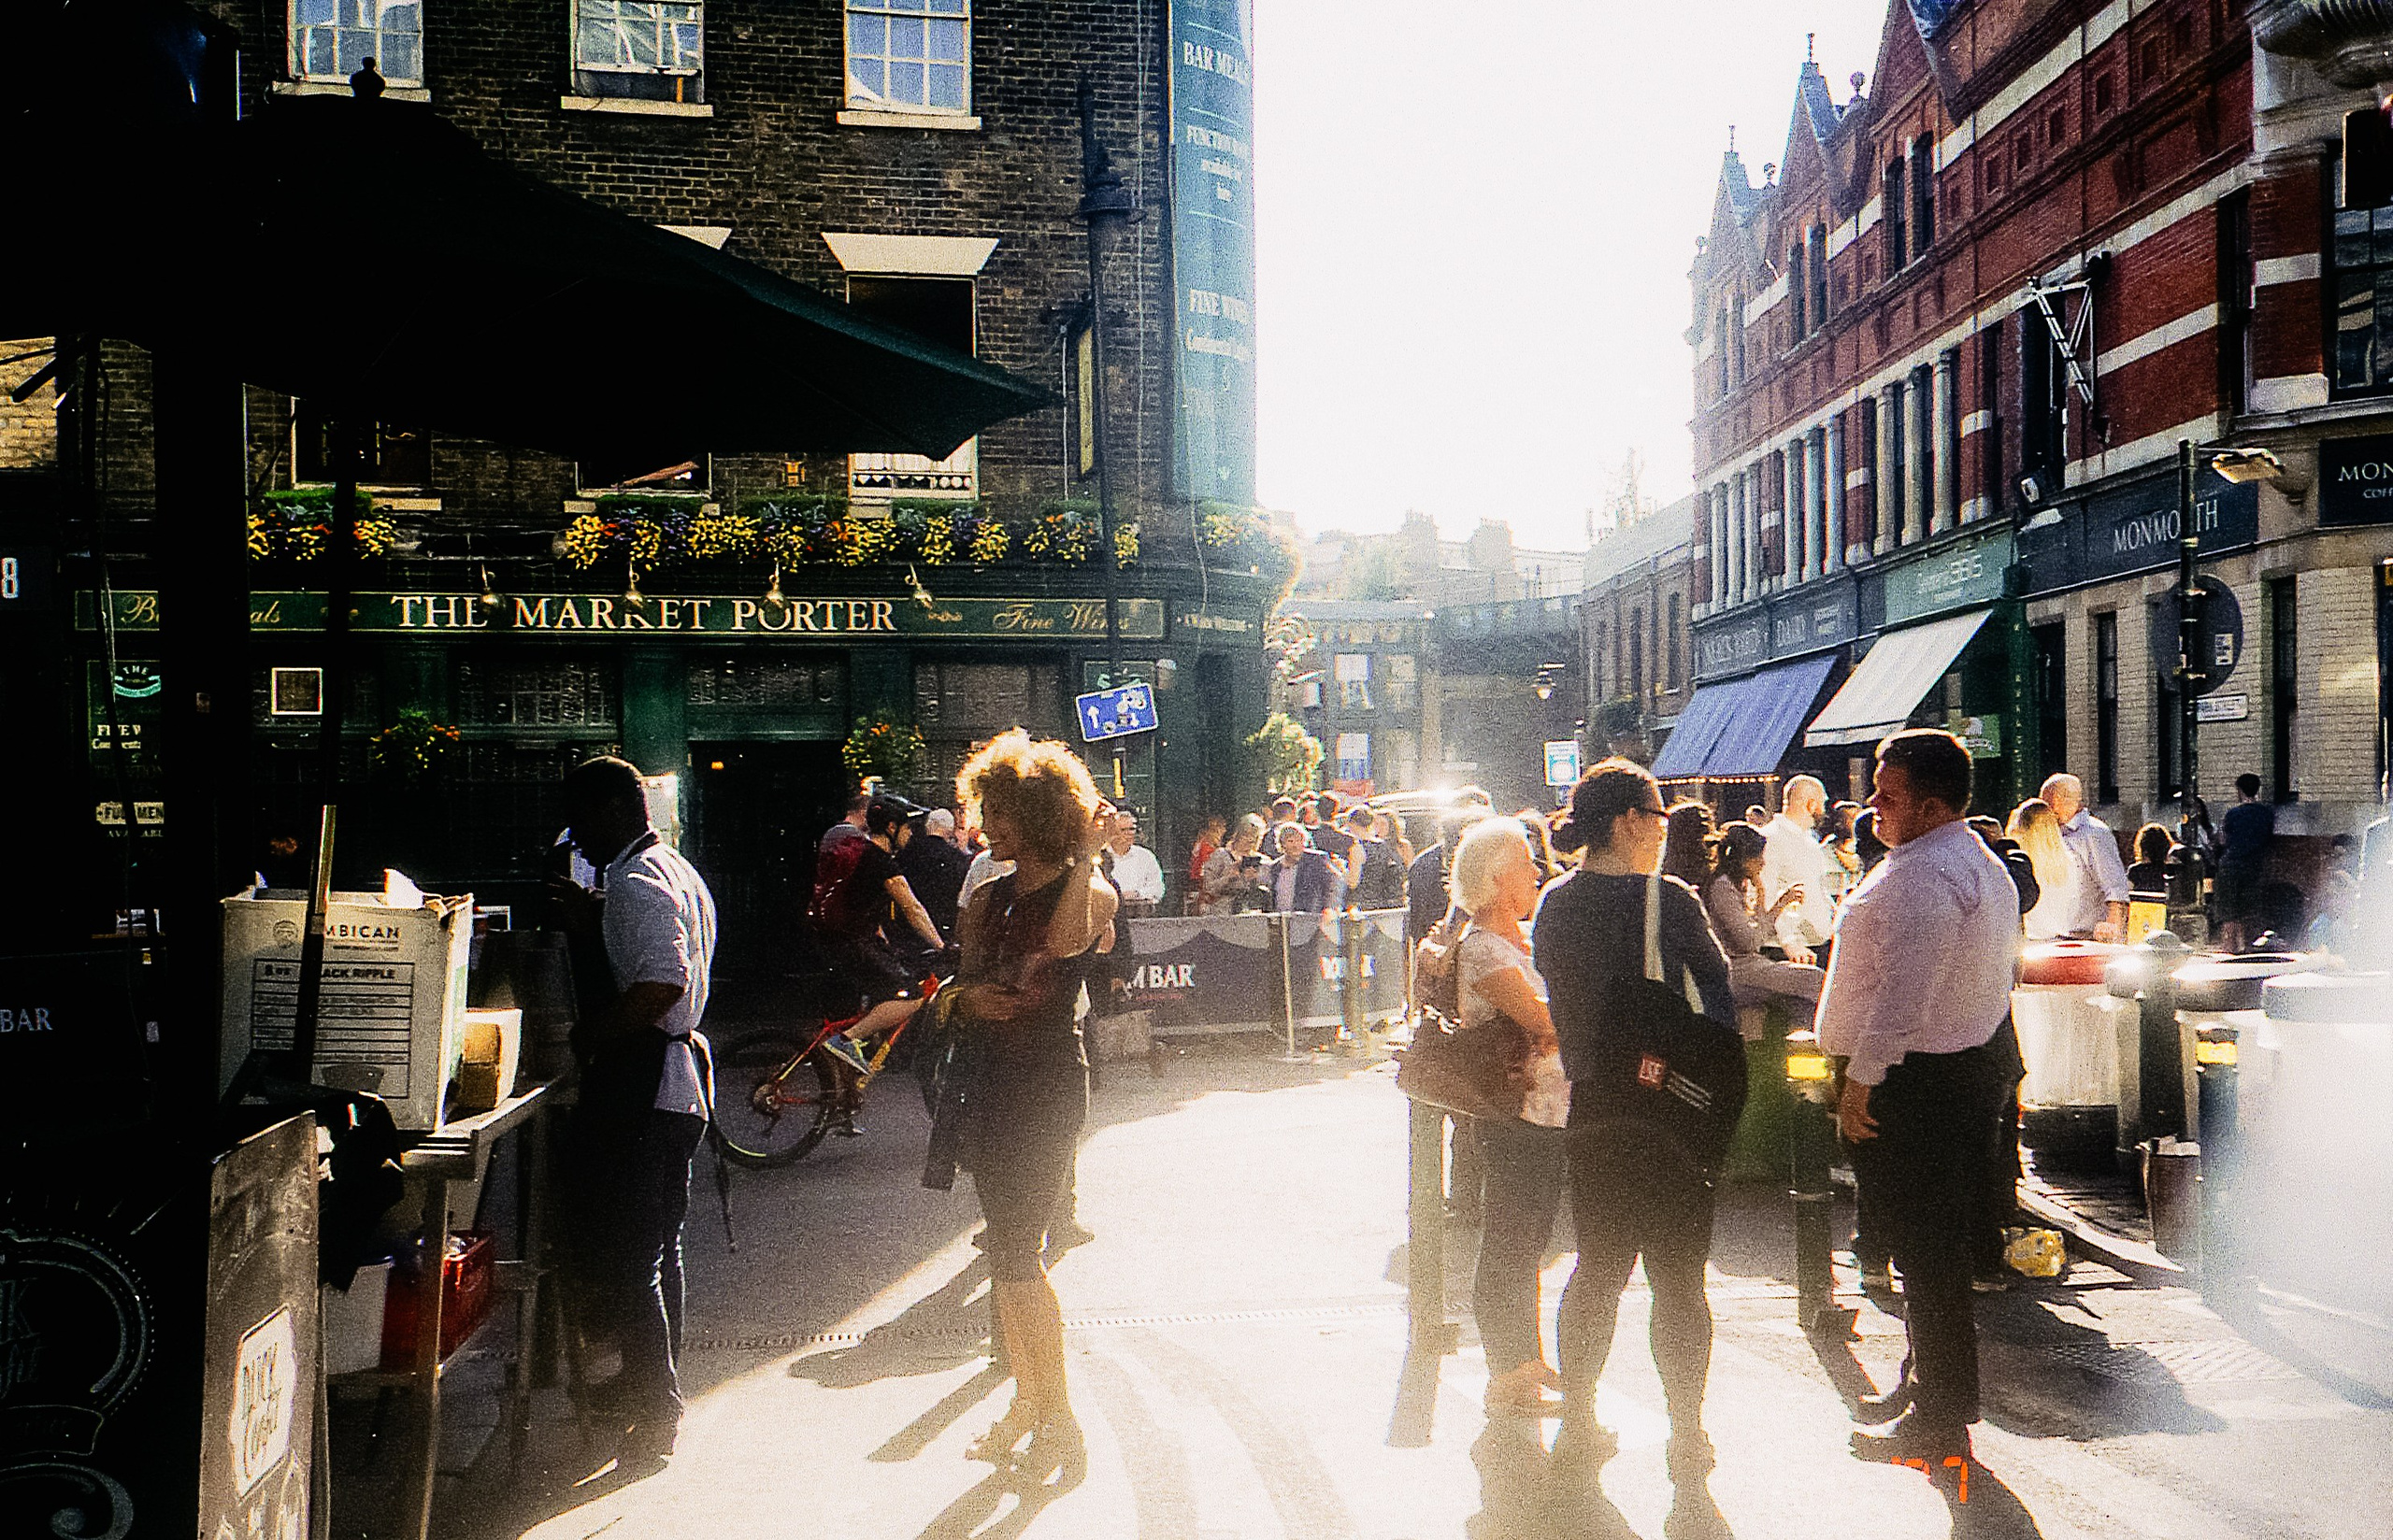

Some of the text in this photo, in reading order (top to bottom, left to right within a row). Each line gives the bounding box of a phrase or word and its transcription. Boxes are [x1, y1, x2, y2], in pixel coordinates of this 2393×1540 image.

[1183, 41, 1213, 71] BAR
[2114, 499, 2218, 553] MONMOTH
[391, 595, 488, 628] THE
[731, 599, 897, 632] PORTER
[993, 604, 1130, 631] Fine Wins
[324, 924, 400, 939] MBICAN
[321, 968, 395, 979] ACK RIPPLE
[1149, 963, 1196, 989] BAR
[0, 1007, 54, 1033] BAR
